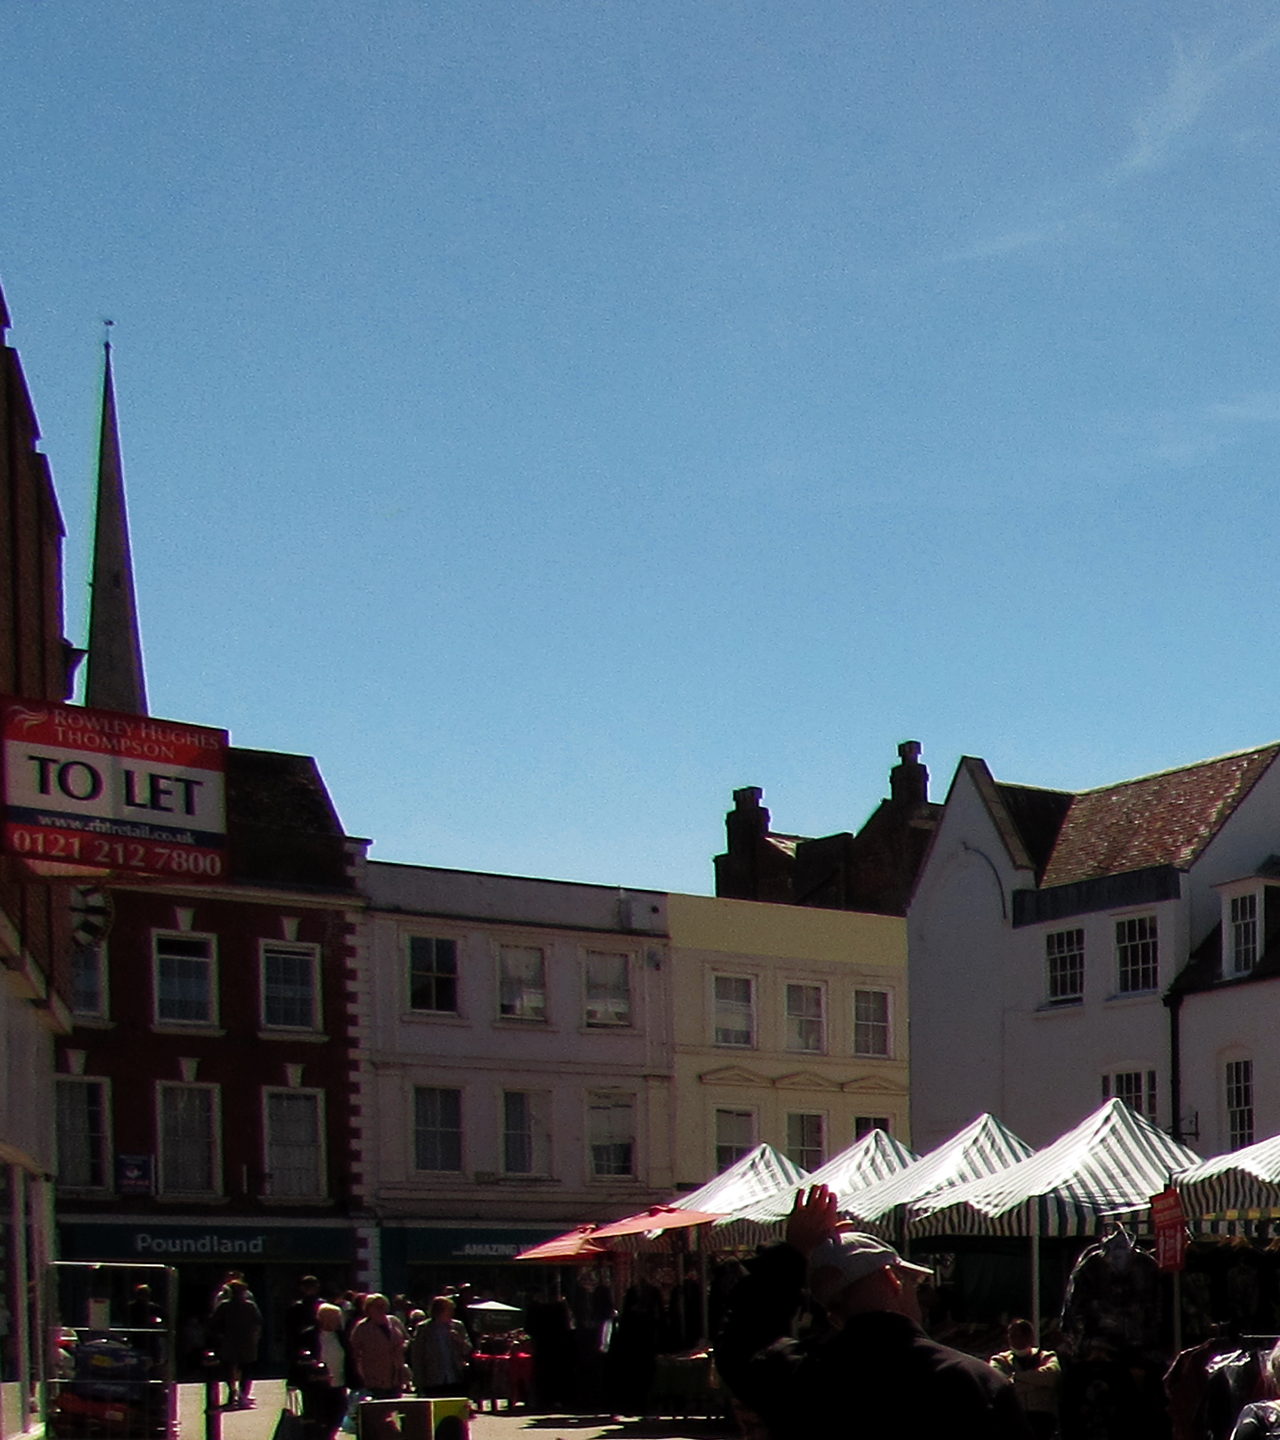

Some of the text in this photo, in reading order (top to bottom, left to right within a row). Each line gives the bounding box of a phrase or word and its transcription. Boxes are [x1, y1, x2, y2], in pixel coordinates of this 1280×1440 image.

[54, 708, 220, 750] ROWLEY HUGHES
[55, 726, 175, 759] THOMPSON
[28, 756, 204, 816] TO LET
[13, 830, 222, 876] 0121 212 7800
[135, 1233, 264, 1253] Poundland
